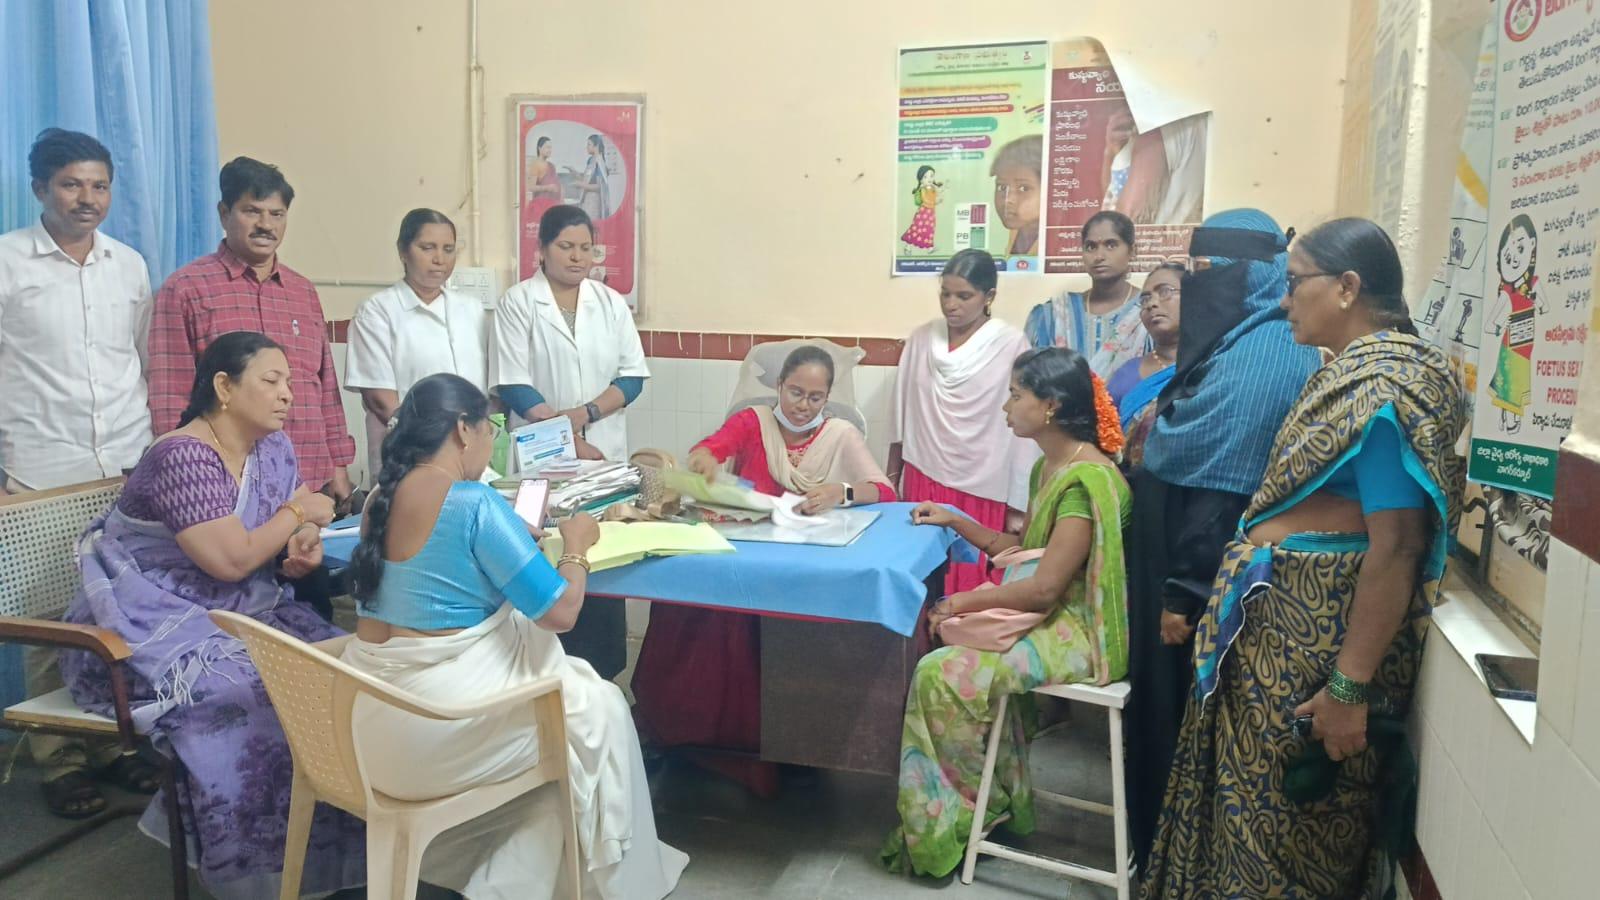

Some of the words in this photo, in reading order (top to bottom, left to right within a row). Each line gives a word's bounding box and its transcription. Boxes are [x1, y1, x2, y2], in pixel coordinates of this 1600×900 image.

[1536, 360, 1566, 377] FOETUS
[1567, 361, 1580, 377] SEX
[1547, 387, 1579, 406] PROCEDU
